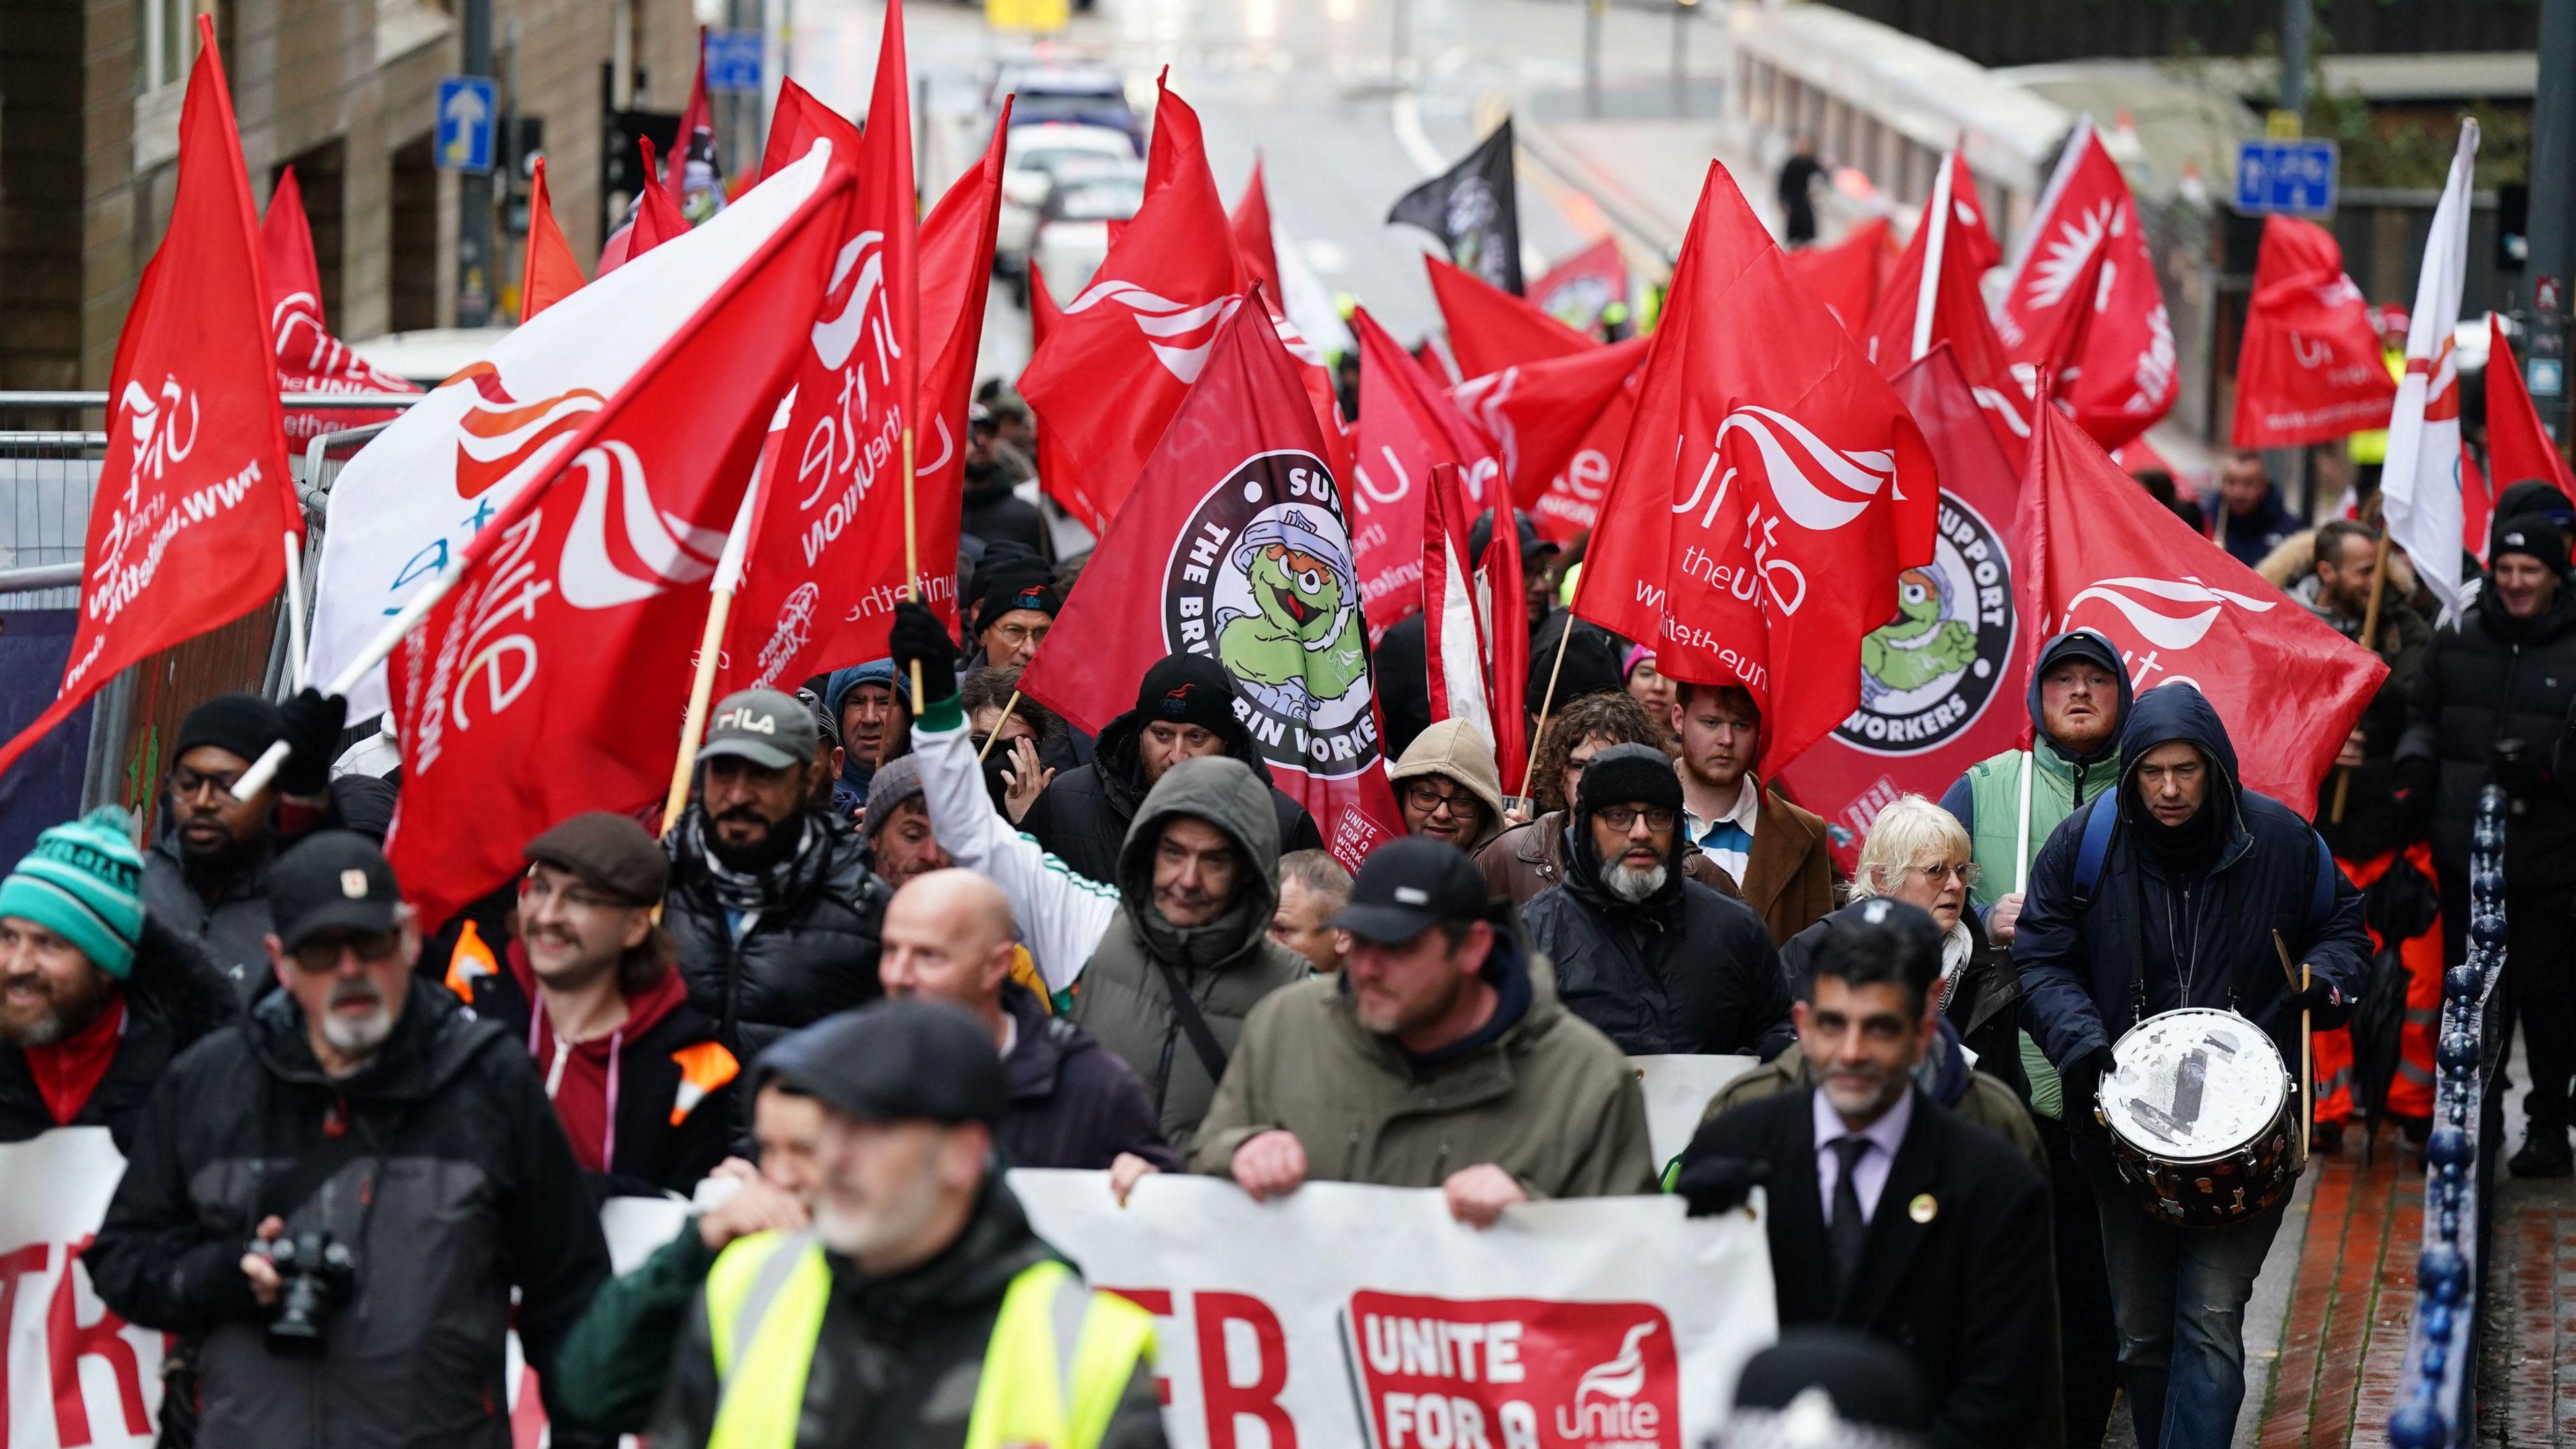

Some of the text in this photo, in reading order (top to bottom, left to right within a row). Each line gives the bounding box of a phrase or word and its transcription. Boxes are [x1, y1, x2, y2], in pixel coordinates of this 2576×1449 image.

[1179, 521, 1231, 659] THE BRU
[717, 706, 776, 736] FILA
[1160, 697, 1186, 710] unite
[1841, 693, 1968, 742] WORKERS
[1232, 696, 1377, 763] BIN WORKE
[1340, 822, 1369, 852] FOR A
[1345, 809, 1377, 839] UNITE
[1336, 834, 1366, 866] WORKE
[1363, 1312, 1525, 1384] UNITE
[1383, 1391, 1493, 1449] FOR
[1555, 1401, 1661, 1440] unite
